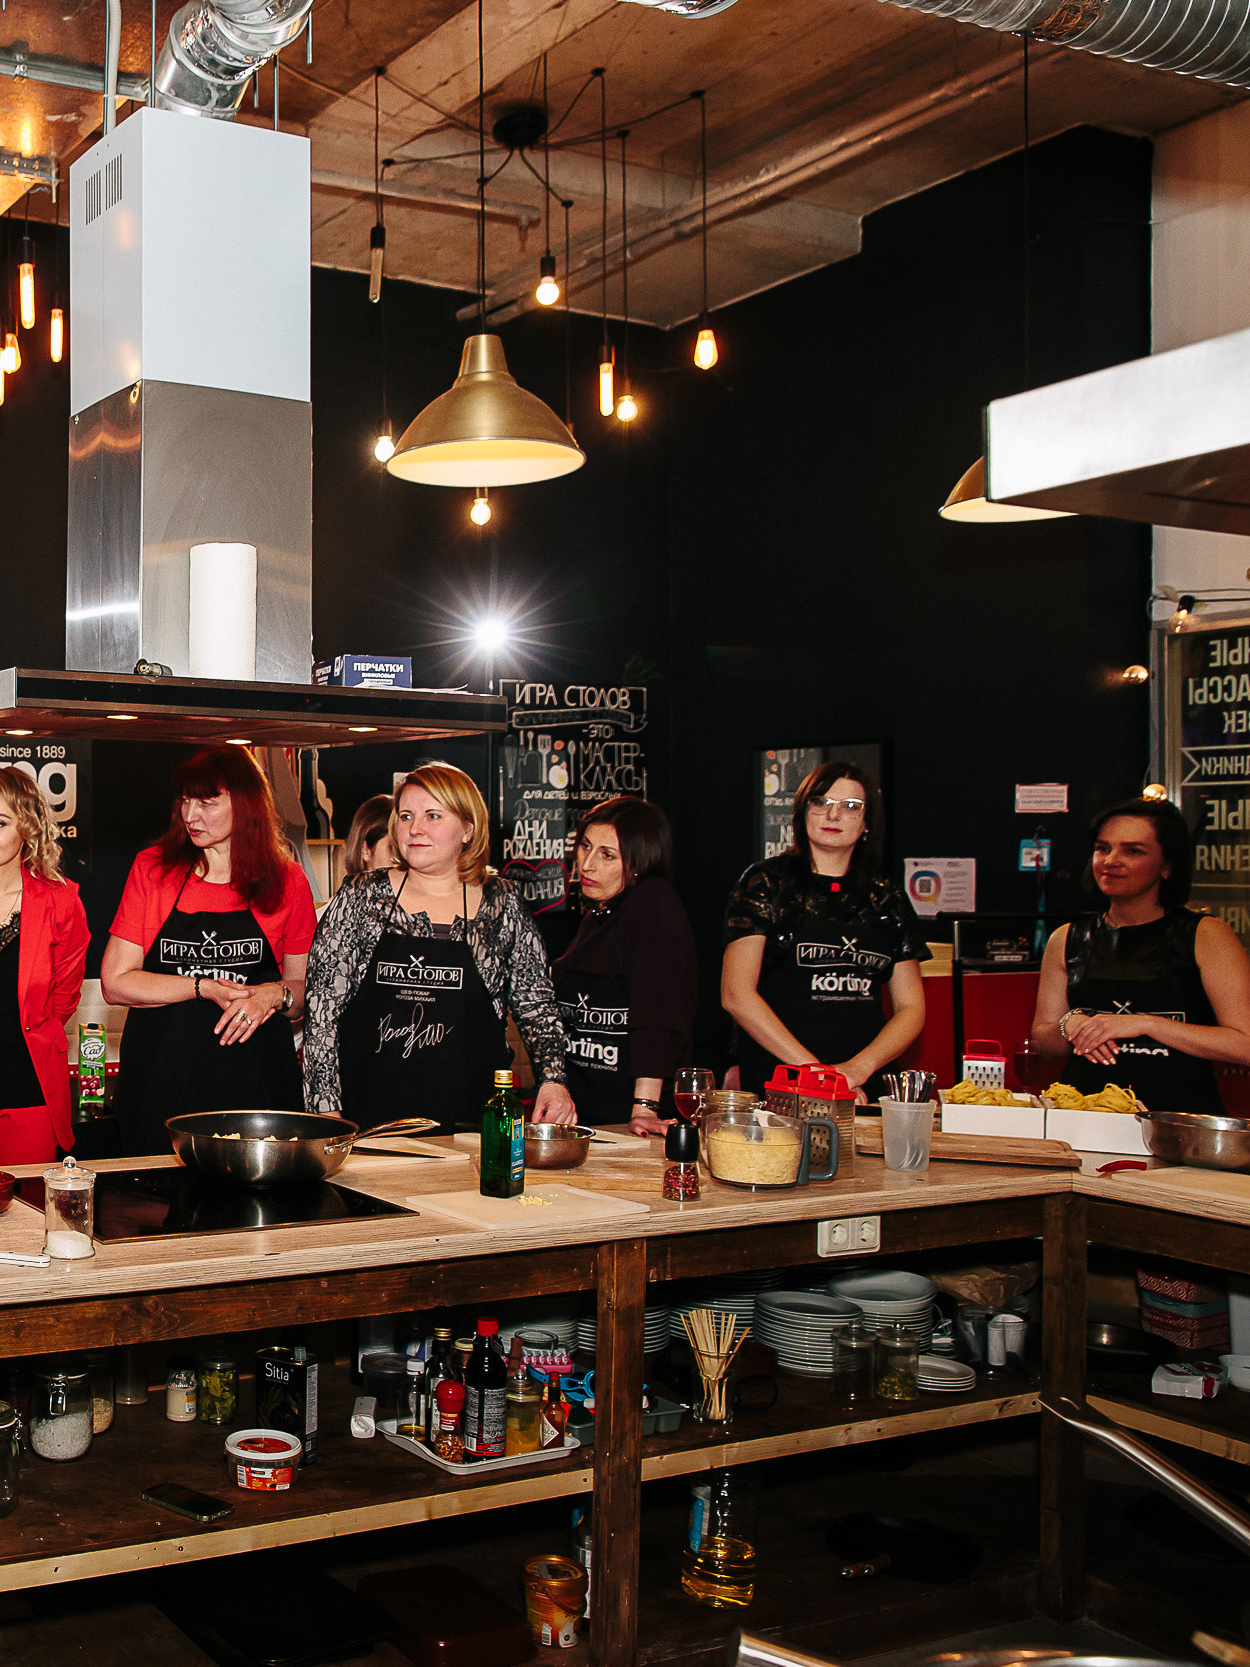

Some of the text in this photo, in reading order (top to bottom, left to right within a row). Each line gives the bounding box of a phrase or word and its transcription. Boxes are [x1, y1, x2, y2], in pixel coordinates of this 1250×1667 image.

[353, 662, 404, 673] ПЕРЧАТКИ
[515, 683, 631, 710] ИГРА СТОЛОВ
[0, 744, 66, 759] since 1889
[513, 820, 548, 840] ДНИ
[503, 838, 565, 860] РОЖДЕНИЯ
[163, 941, 260, 958] ИГРА СТОЛОВ
[379, 964, 459, 982] ИГРА СТОЛОВ
[811, 972, 872, 996] körting
[265, 1361, 290, 1381] Sitia
